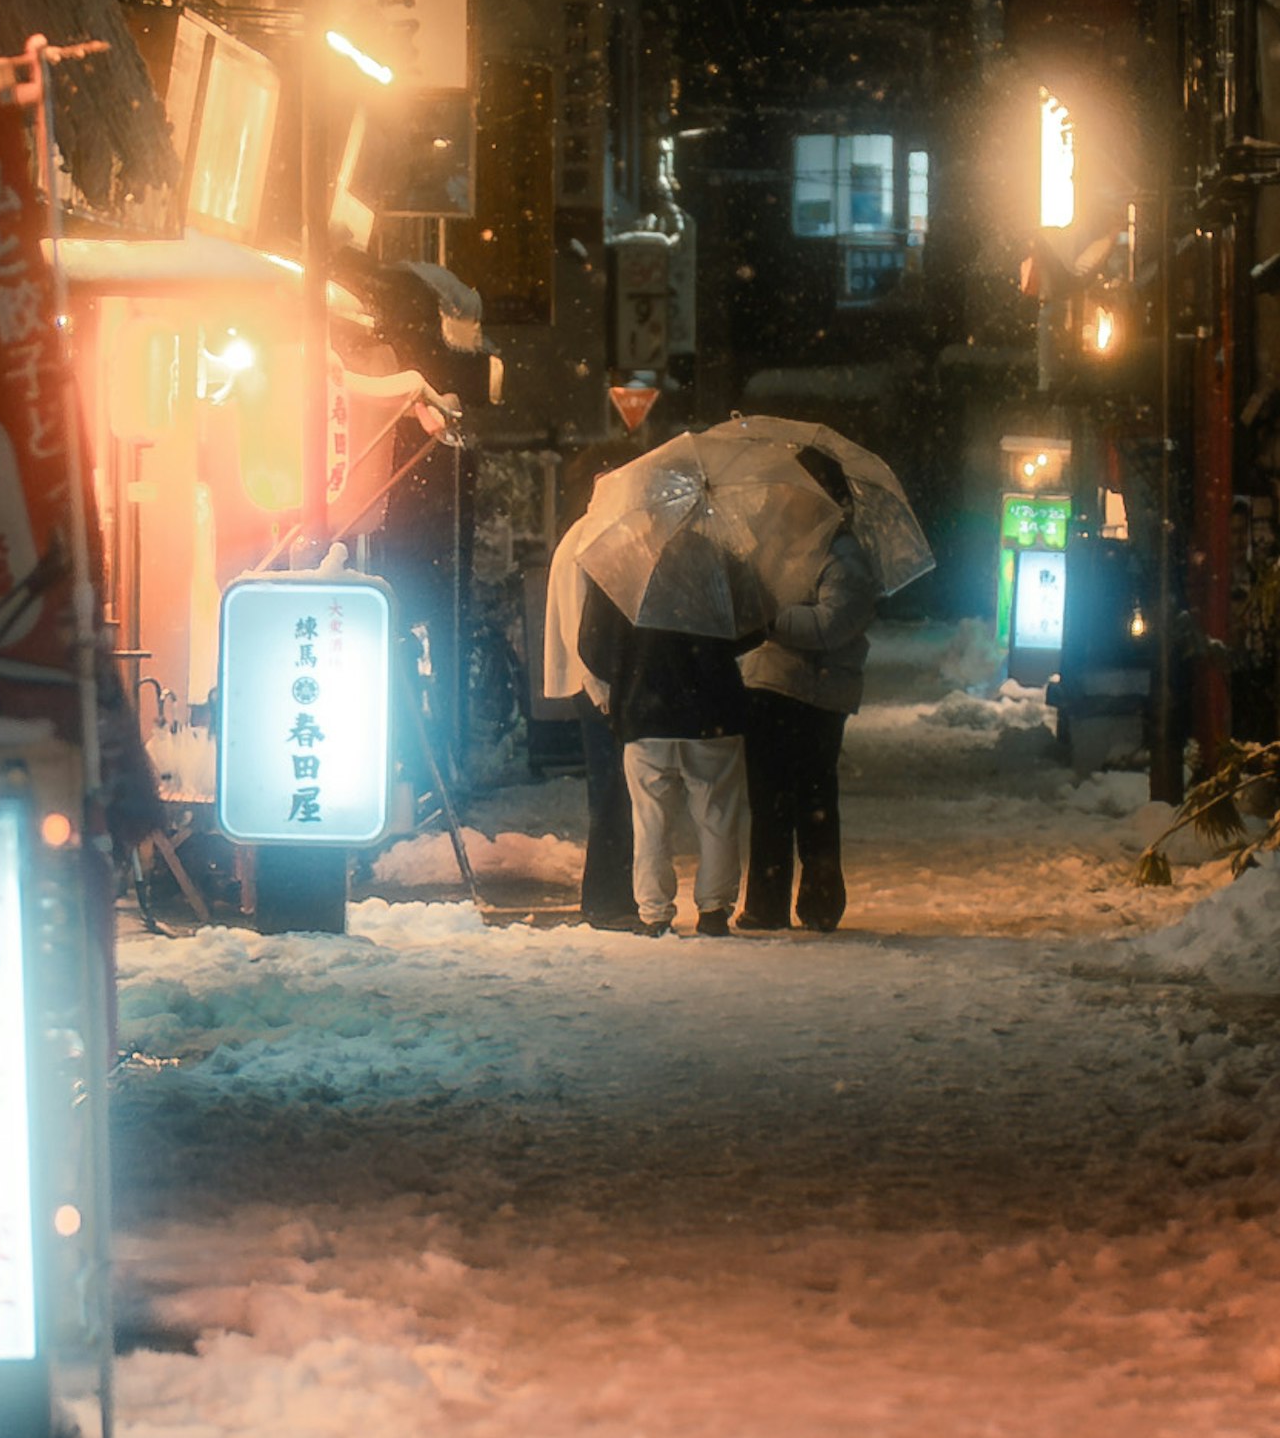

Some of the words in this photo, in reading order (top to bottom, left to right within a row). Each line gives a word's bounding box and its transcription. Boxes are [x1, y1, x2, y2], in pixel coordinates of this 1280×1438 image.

[294, 615, 319, 668] 練馬
[286, 712, 325, 823] 春田屋
